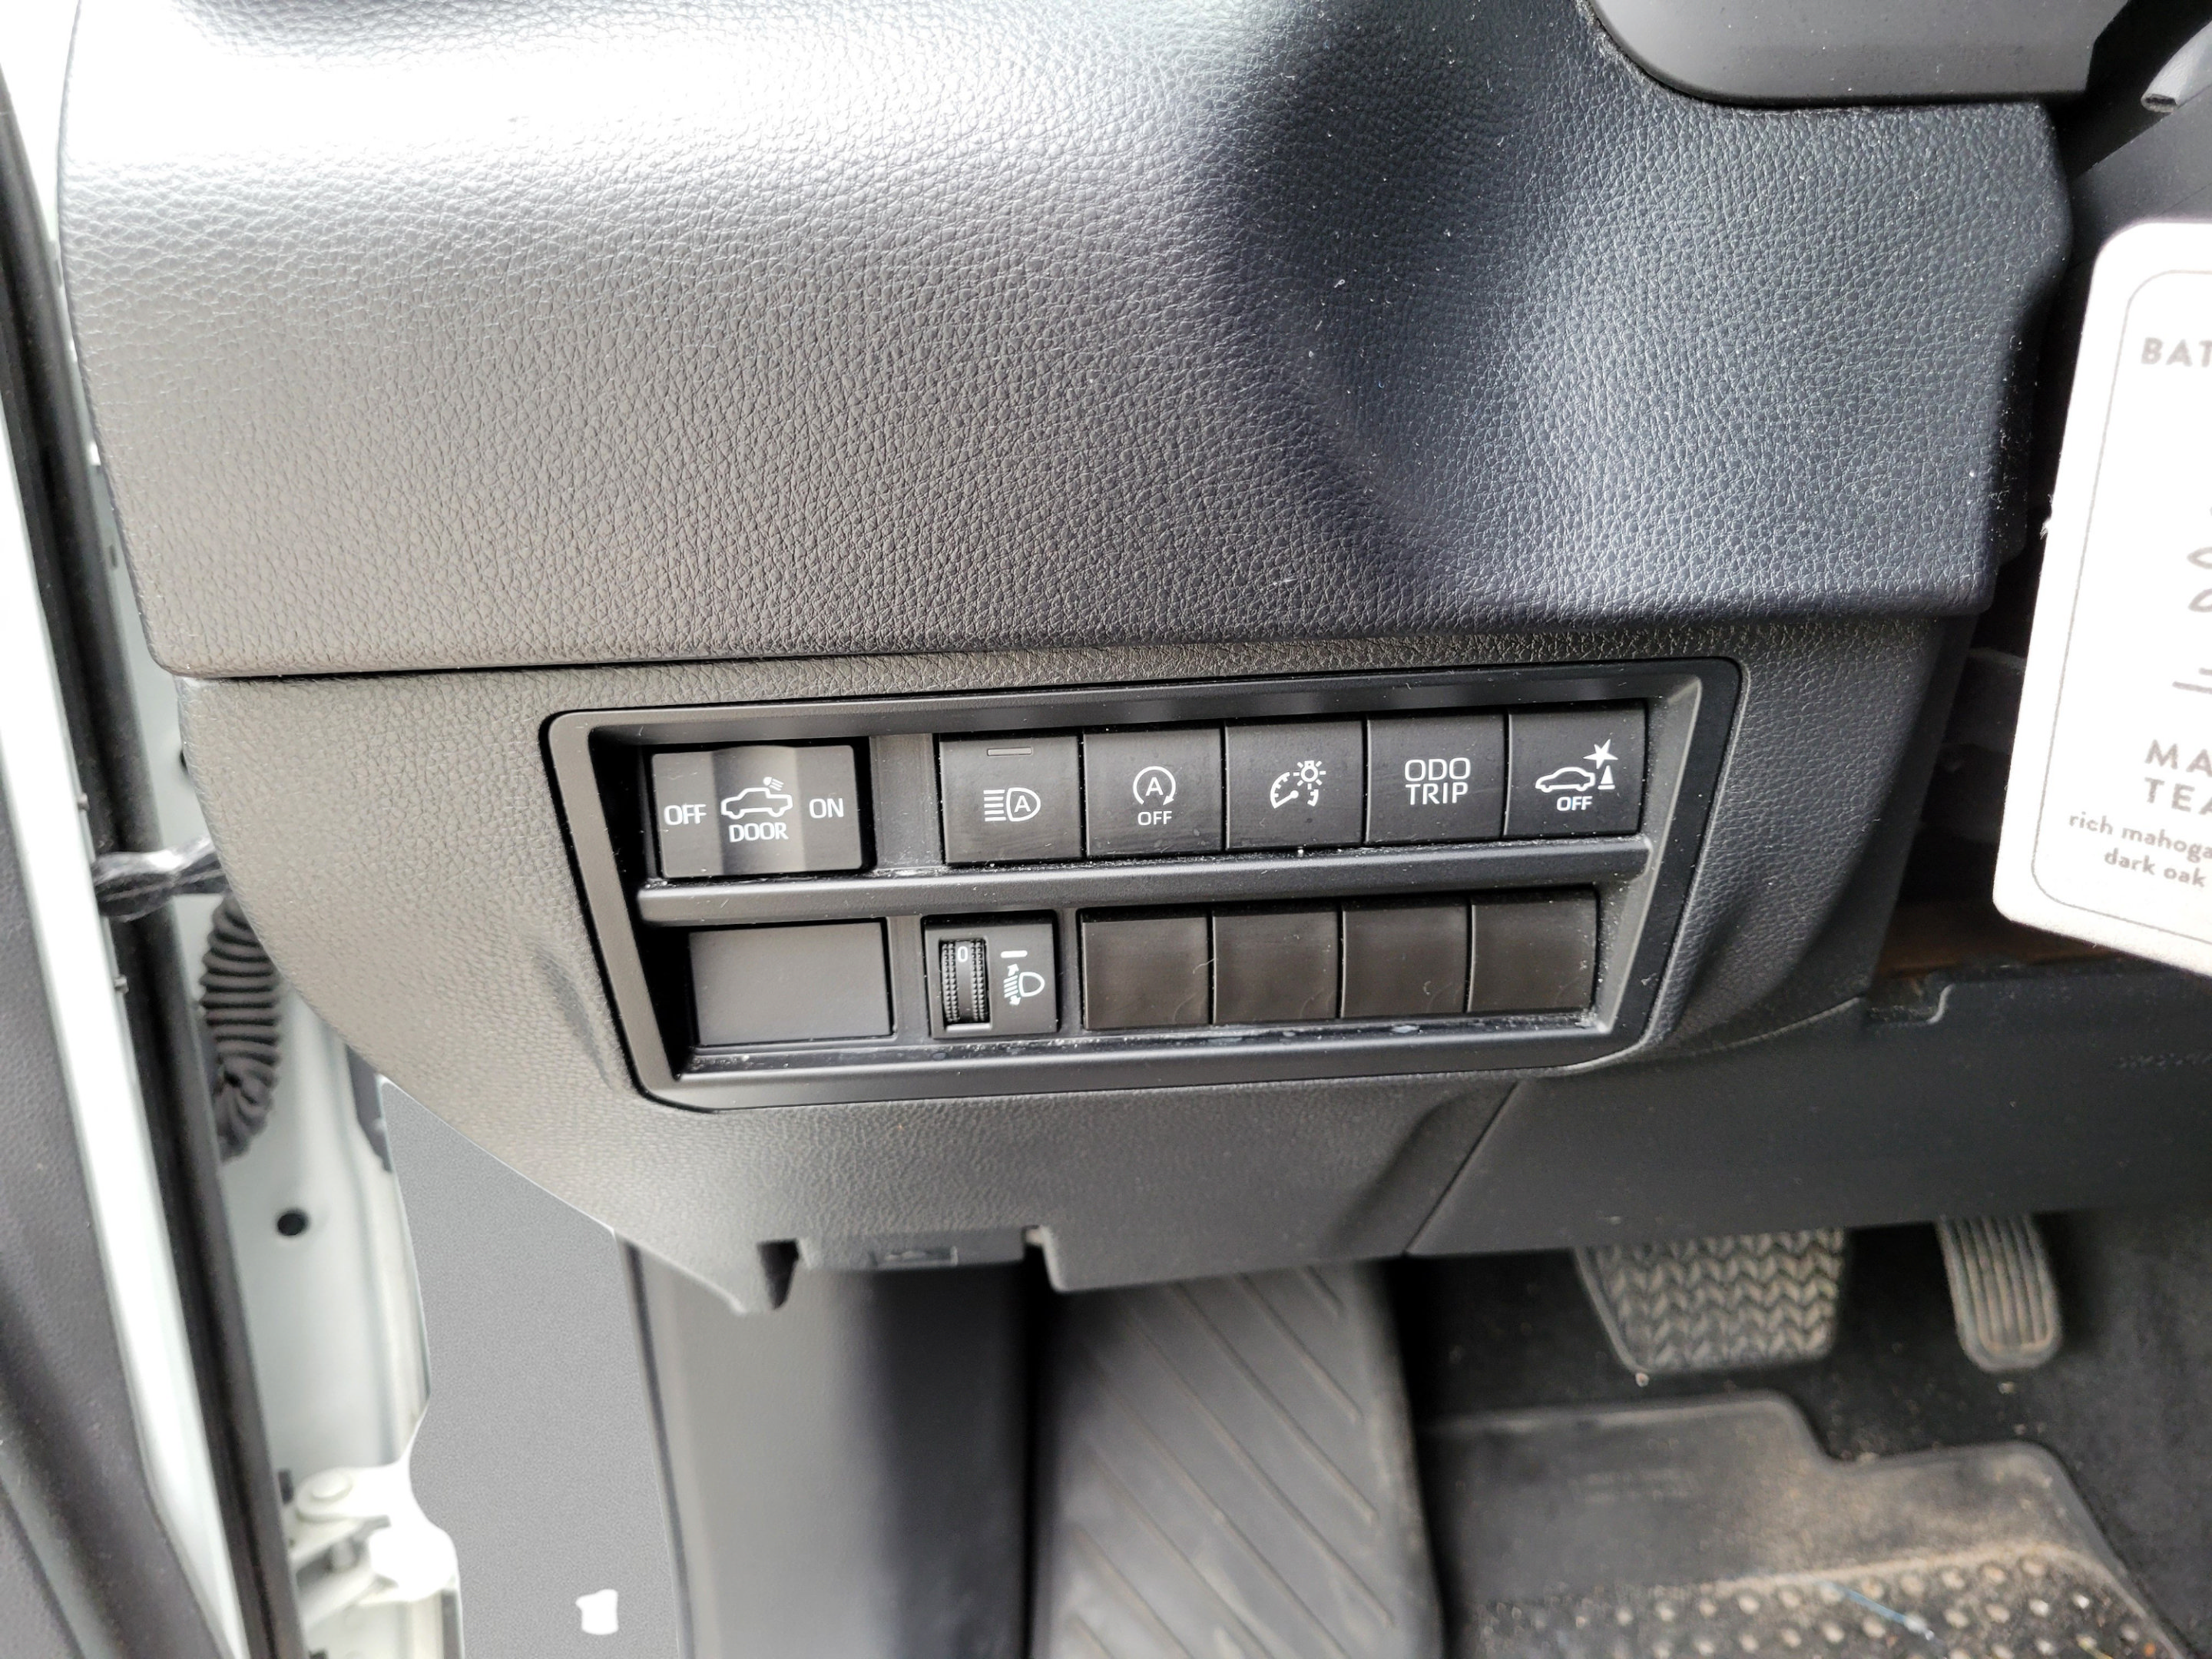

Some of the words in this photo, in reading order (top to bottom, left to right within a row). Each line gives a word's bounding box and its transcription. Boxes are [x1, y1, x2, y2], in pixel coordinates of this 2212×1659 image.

[2142, 338, 2212, 366] BAT
[1404, 757, 1471, 781] ODO
[2144, 739, 2212, 778] MA
[1405, 781, 1469, 805] TRIP
[1557, 795, 1593, 812] OFF
[664, 803, 707, 826] OFF
[809, 797, 844, 819] ON
[1137, 810, 1173, 826] OFF
[730, 821, 788, 843] DOOR
[2069, 811, 2114, 835] rich
[2121, 829, 2212, 863] mahoga
[2104, 847, 2155, 875] dark
[2164, 867, 2207, 888] oak
[957, 945, 969, 963] 0
